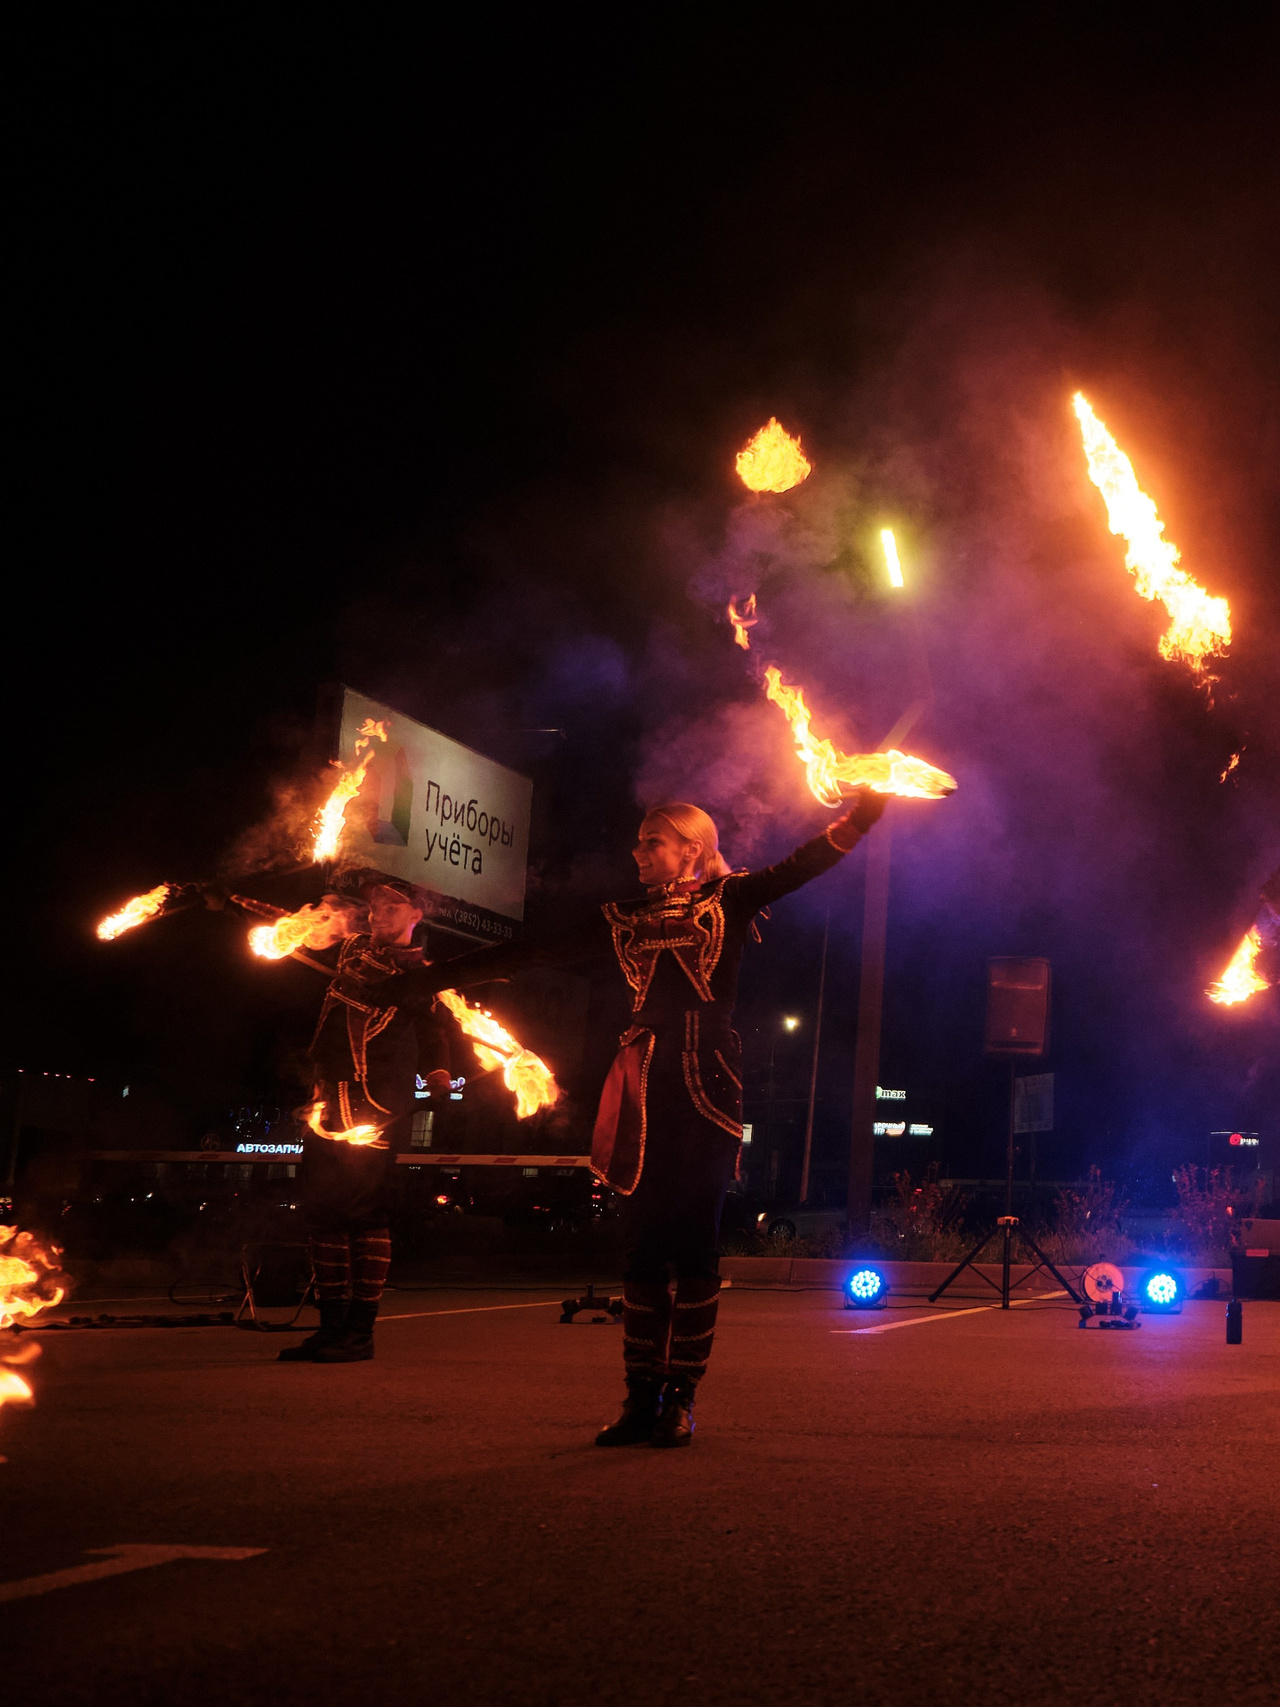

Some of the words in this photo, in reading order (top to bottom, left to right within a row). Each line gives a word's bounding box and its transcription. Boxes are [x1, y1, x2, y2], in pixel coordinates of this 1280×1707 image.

[425, 780, 515, 847] Приборы
[424, 829, 483, 875] учёта
[481, 918, 513, 940] 43-33-33
